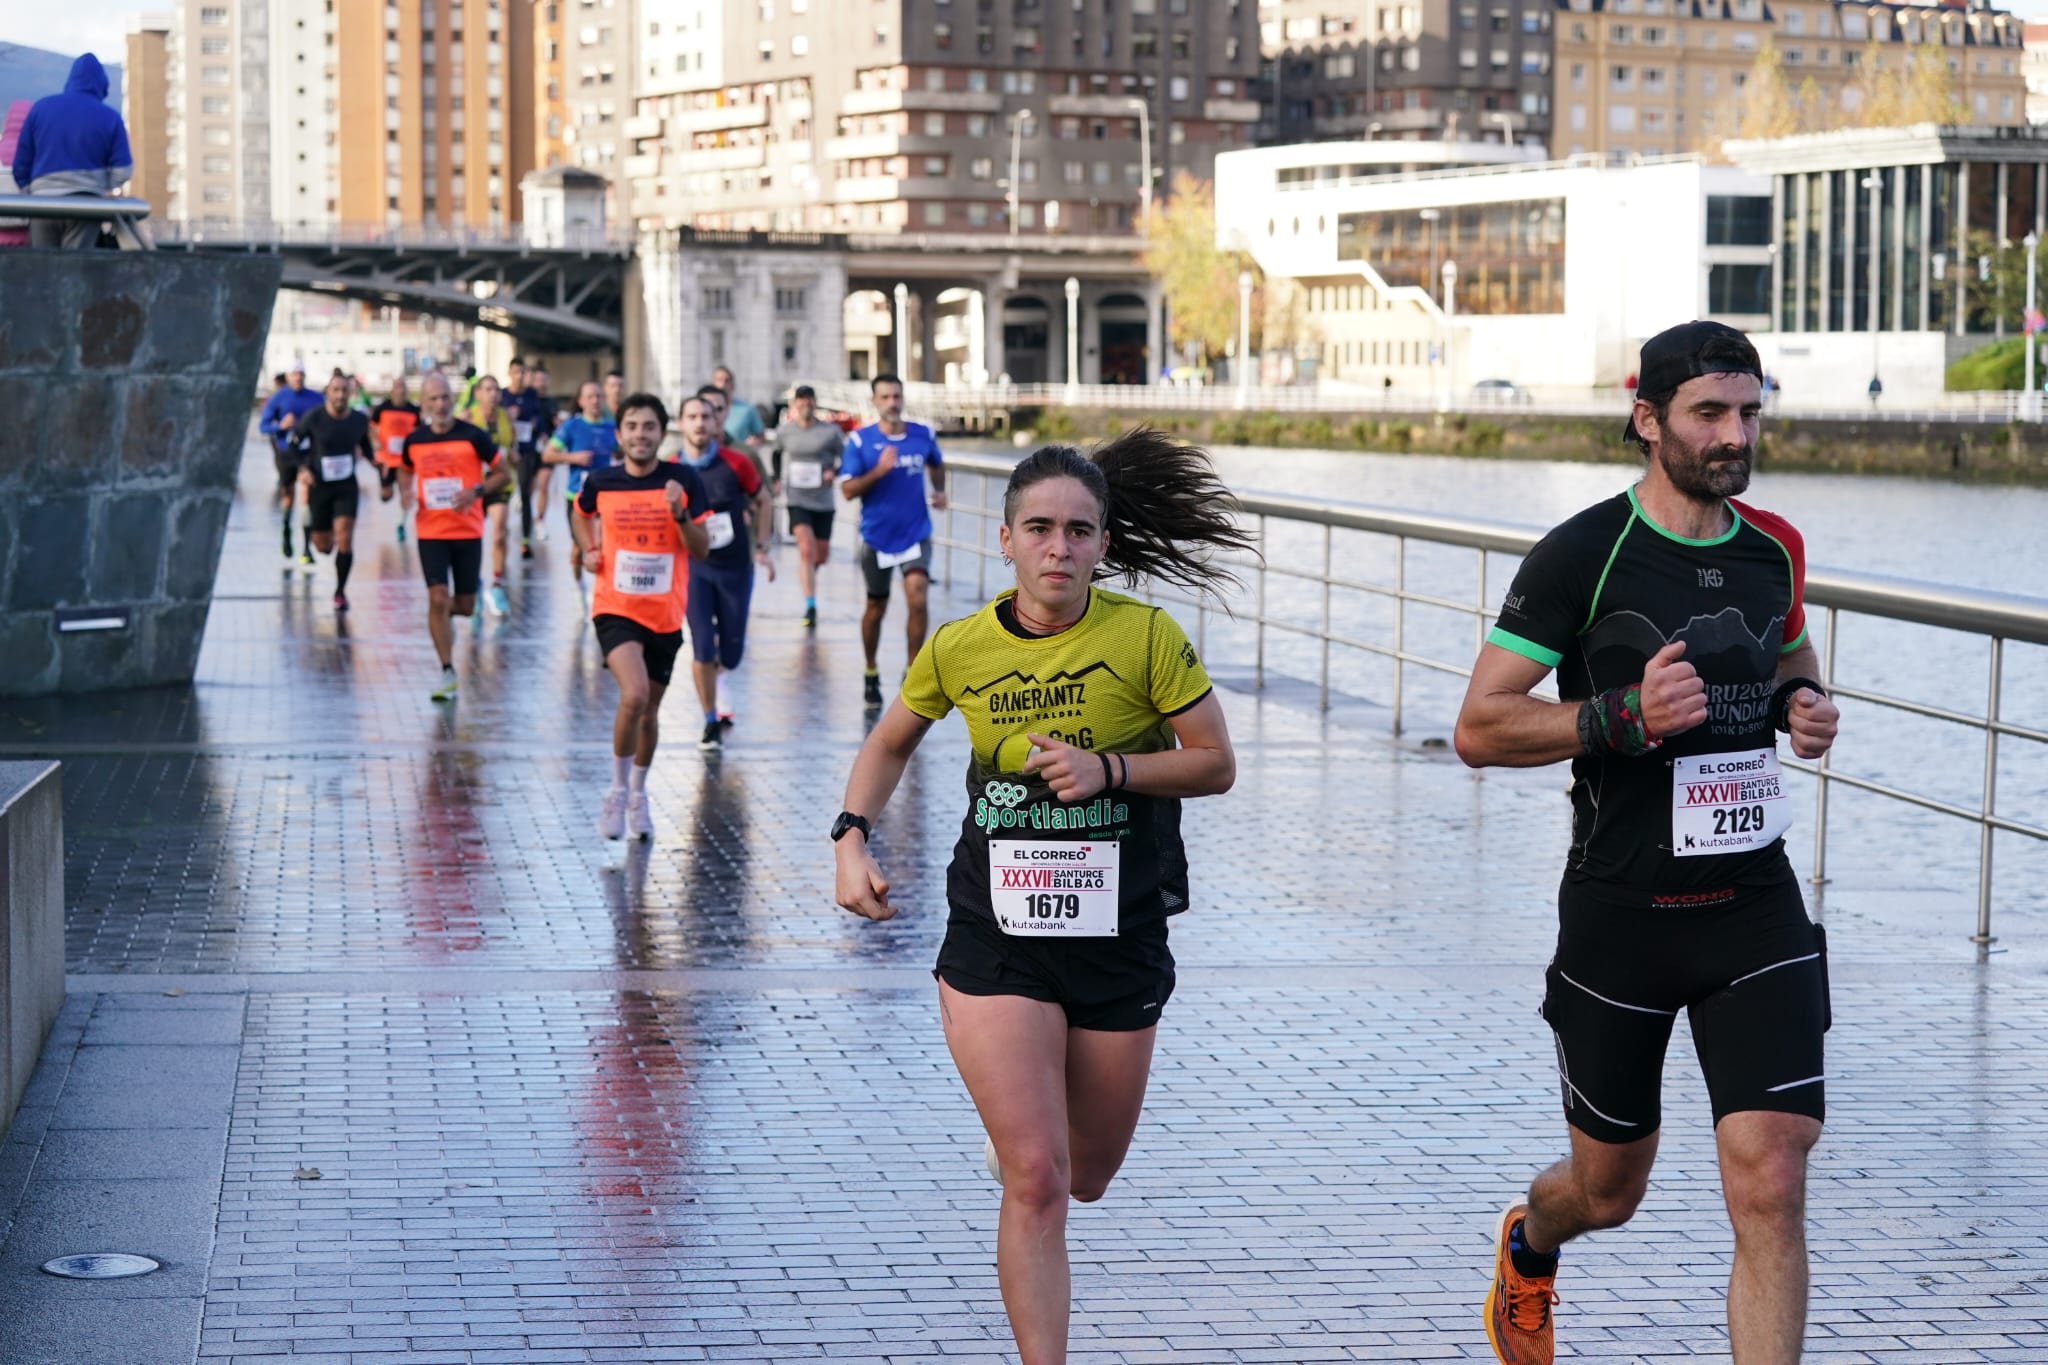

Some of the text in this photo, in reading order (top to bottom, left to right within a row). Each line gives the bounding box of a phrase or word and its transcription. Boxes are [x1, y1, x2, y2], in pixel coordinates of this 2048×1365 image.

[989, 683, 1086, 713] GANERANTZ
[992, 710, 1083, 725] MENDI TALDEA
[1699, 759, 1765, 774] EL CORREO
[1686, 782, 1738, 805] XXXVII
[1740, 777, 1779, 790] SANTURCE
[1740, 786, 1780, 801] BILBAO
[975, 798, 1129, 835] Sportlandia
[1713, 805, 1764, 835] 2129
[1088, 830, 1112, 839] desde
[1700, 835, 1753, 848] kutxabank
[1014, 850, 1086, 861] EL CORREO
[1001, 869, 1051, 888] XXXVII
[1054, 870, 1104, 879] SANTURCE
[1054, 879, 1104, 889] BILBAO
[1025, 893, 1080, 919] 1679
[1012, 920, 1066, 931] kutxabank
